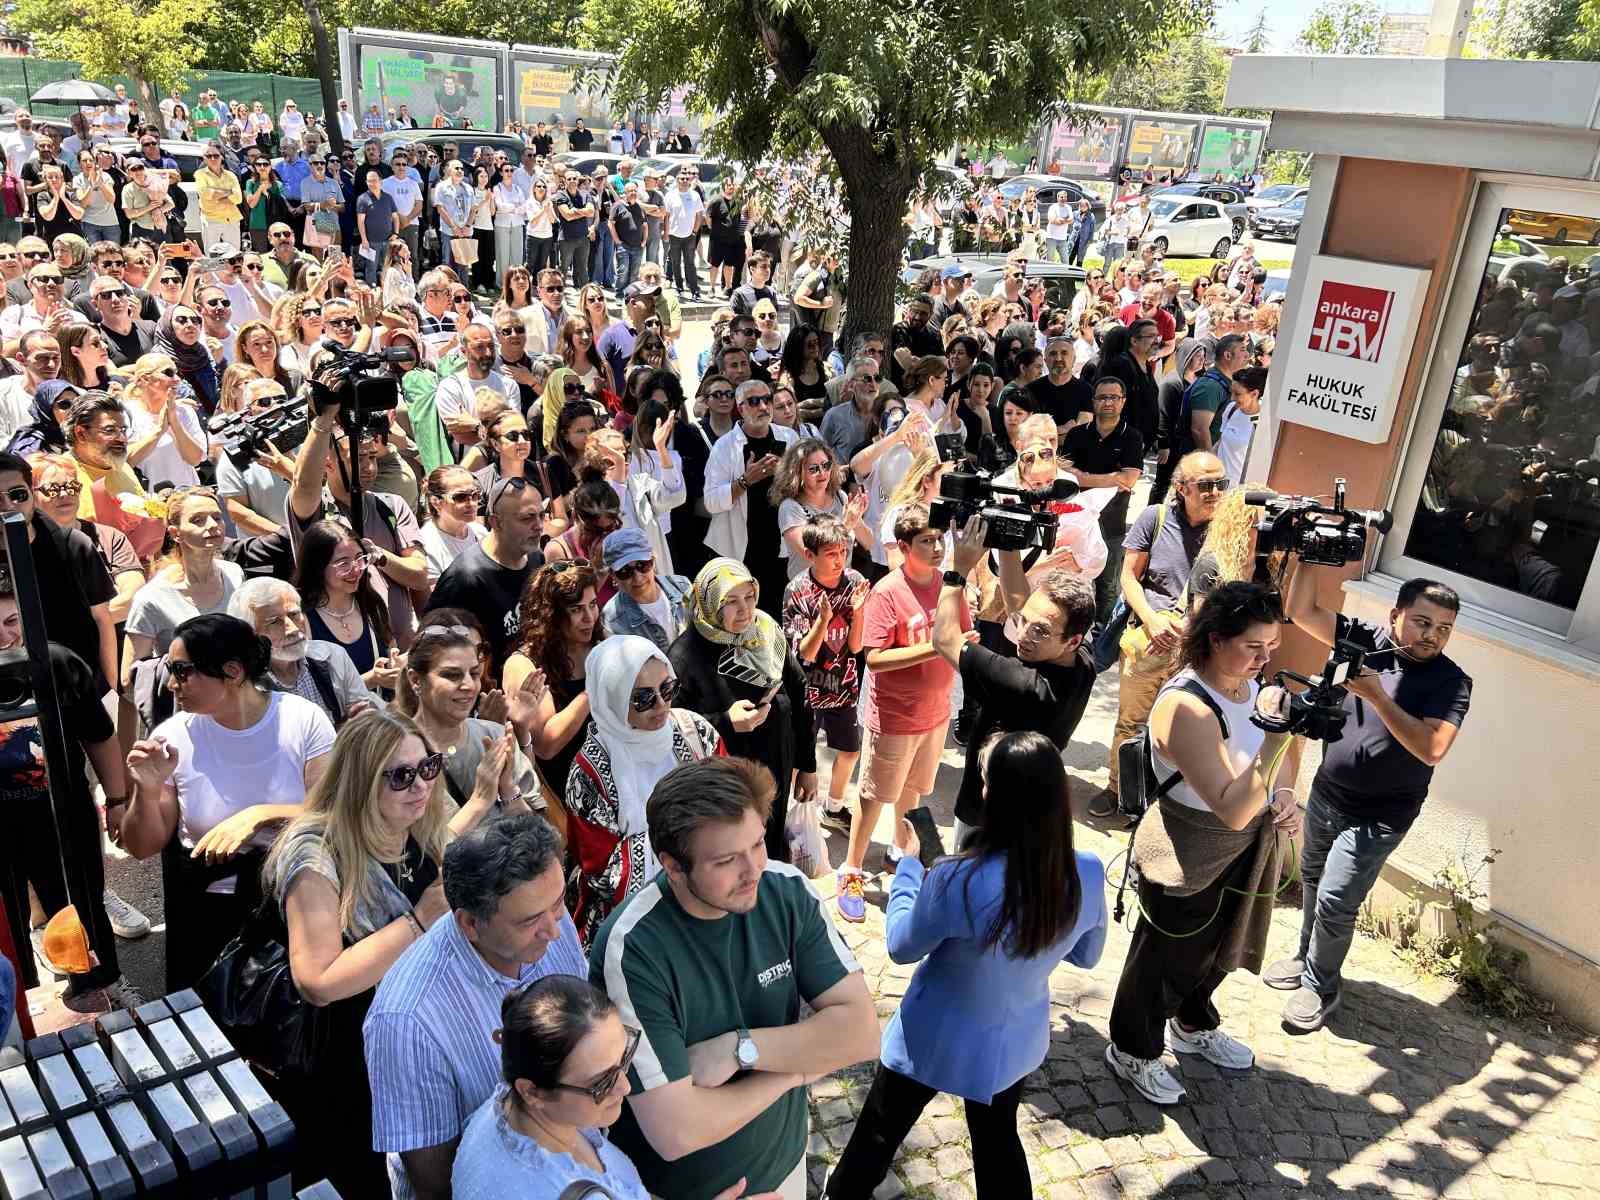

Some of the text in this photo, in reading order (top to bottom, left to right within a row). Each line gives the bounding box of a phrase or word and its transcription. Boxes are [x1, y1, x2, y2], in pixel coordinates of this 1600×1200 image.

[1320, 301, 1379, 323] ankara
[1306, 373, 1365, 398] HUKUK
[1287, 388, 1378, 422] FAKÜLTESİ
[757, 959, 792, 983] DISTRIC
